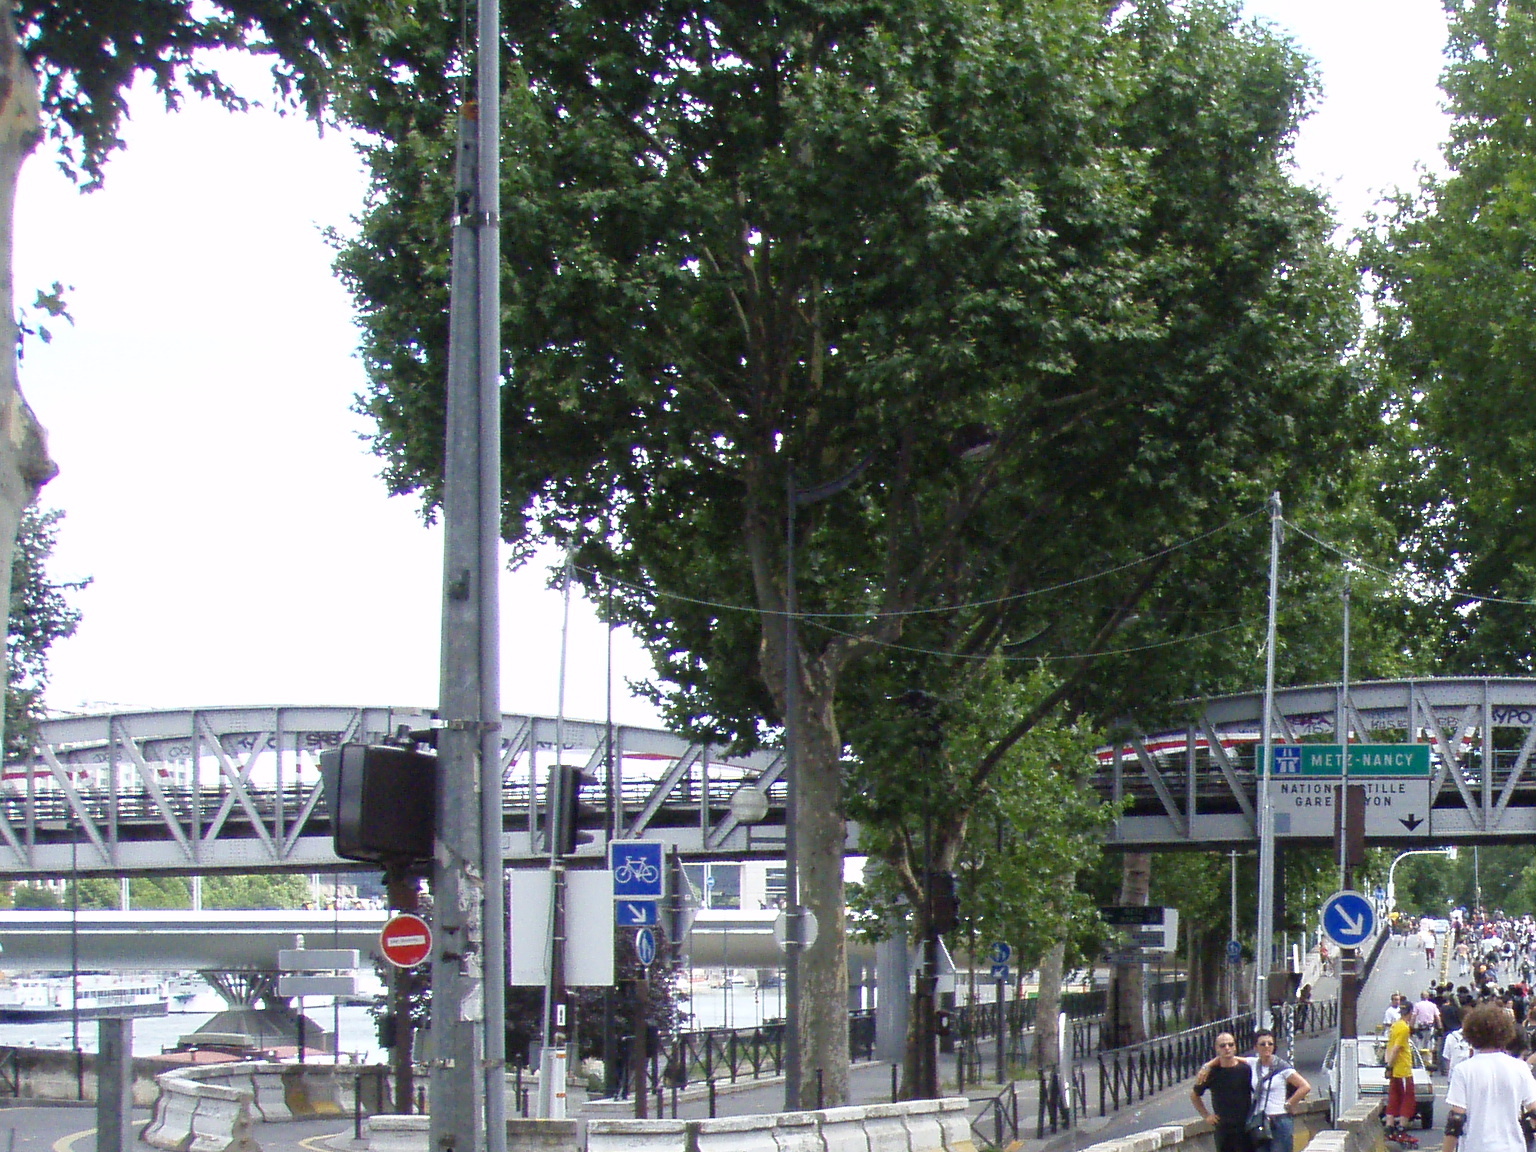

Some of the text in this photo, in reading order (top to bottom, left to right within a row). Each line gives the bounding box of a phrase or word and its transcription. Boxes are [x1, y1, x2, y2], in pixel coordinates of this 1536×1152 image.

[1311, 753, 1414, 767] METZ-NANCY
[1281, 783, 1332, 794] NATION
[1295, 797, 1392, 807] GARE YON
